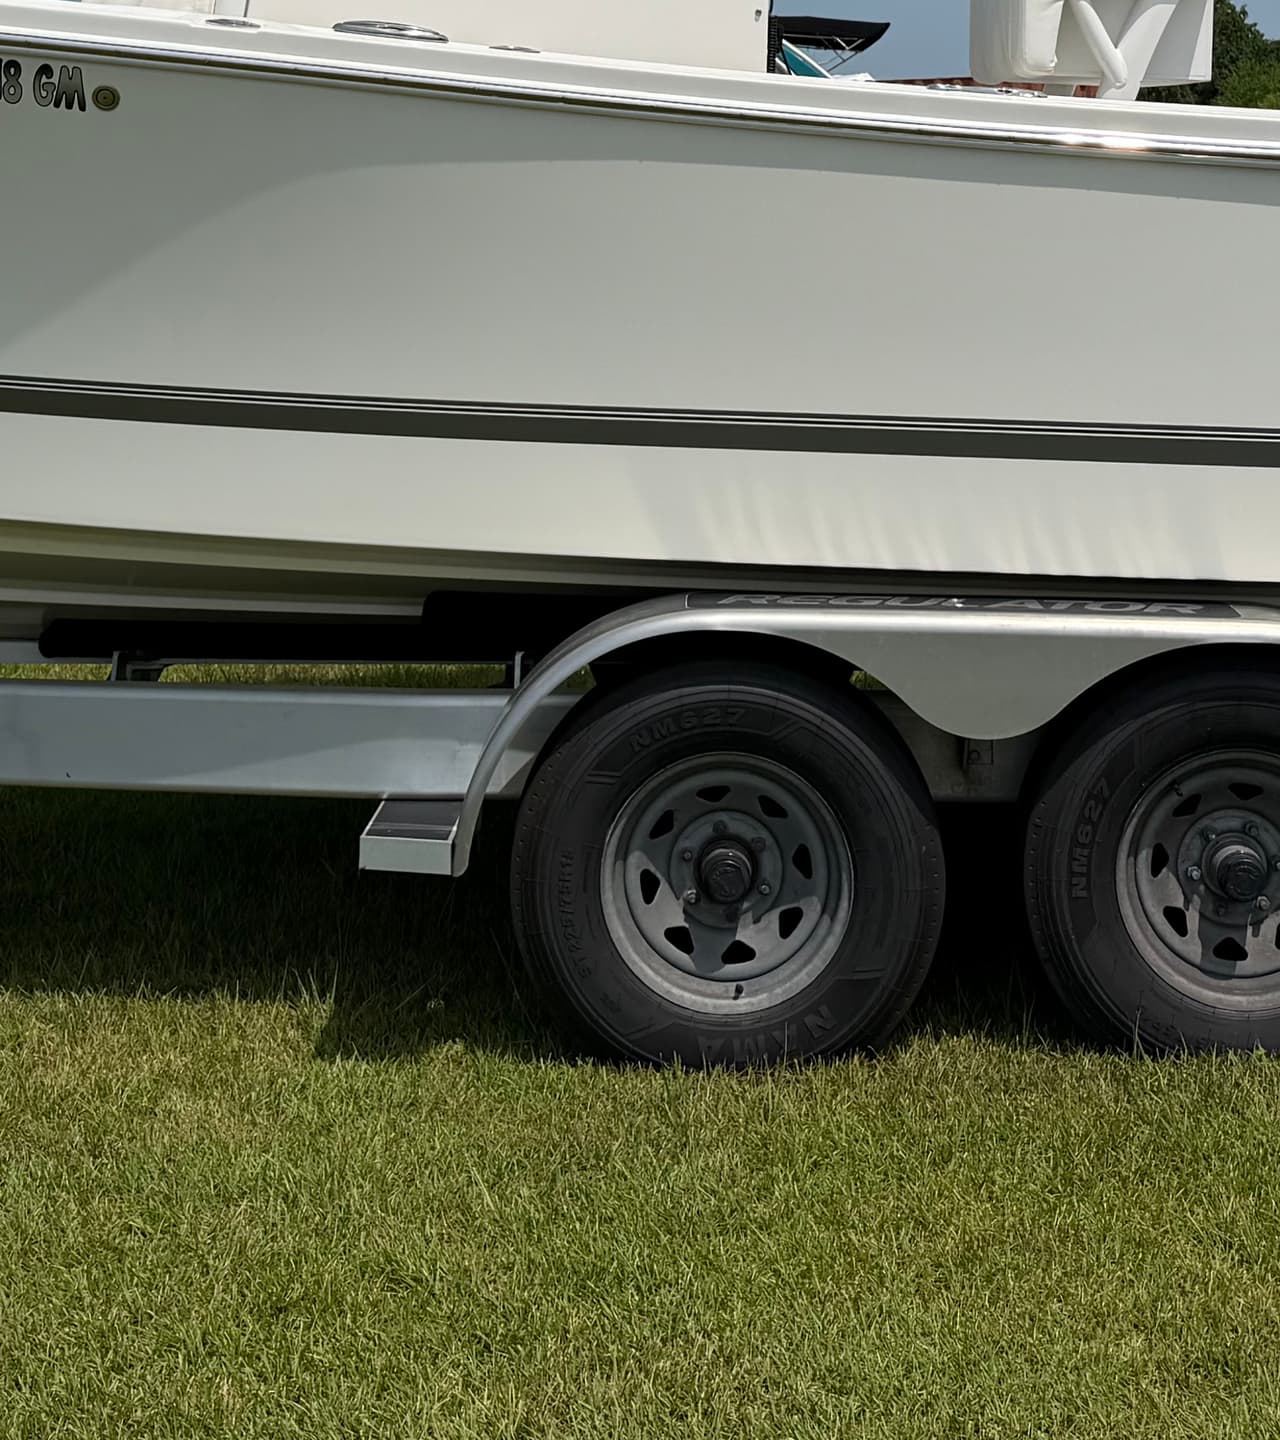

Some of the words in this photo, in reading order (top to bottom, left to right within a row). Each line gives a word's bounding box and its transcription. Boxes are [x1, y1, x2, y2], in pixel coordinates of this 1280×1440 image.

[32, 63, 87, 112] GM
[716, 594, 1205, 615] REGULATOR
[1071, 776, 1110, 900] NM627
